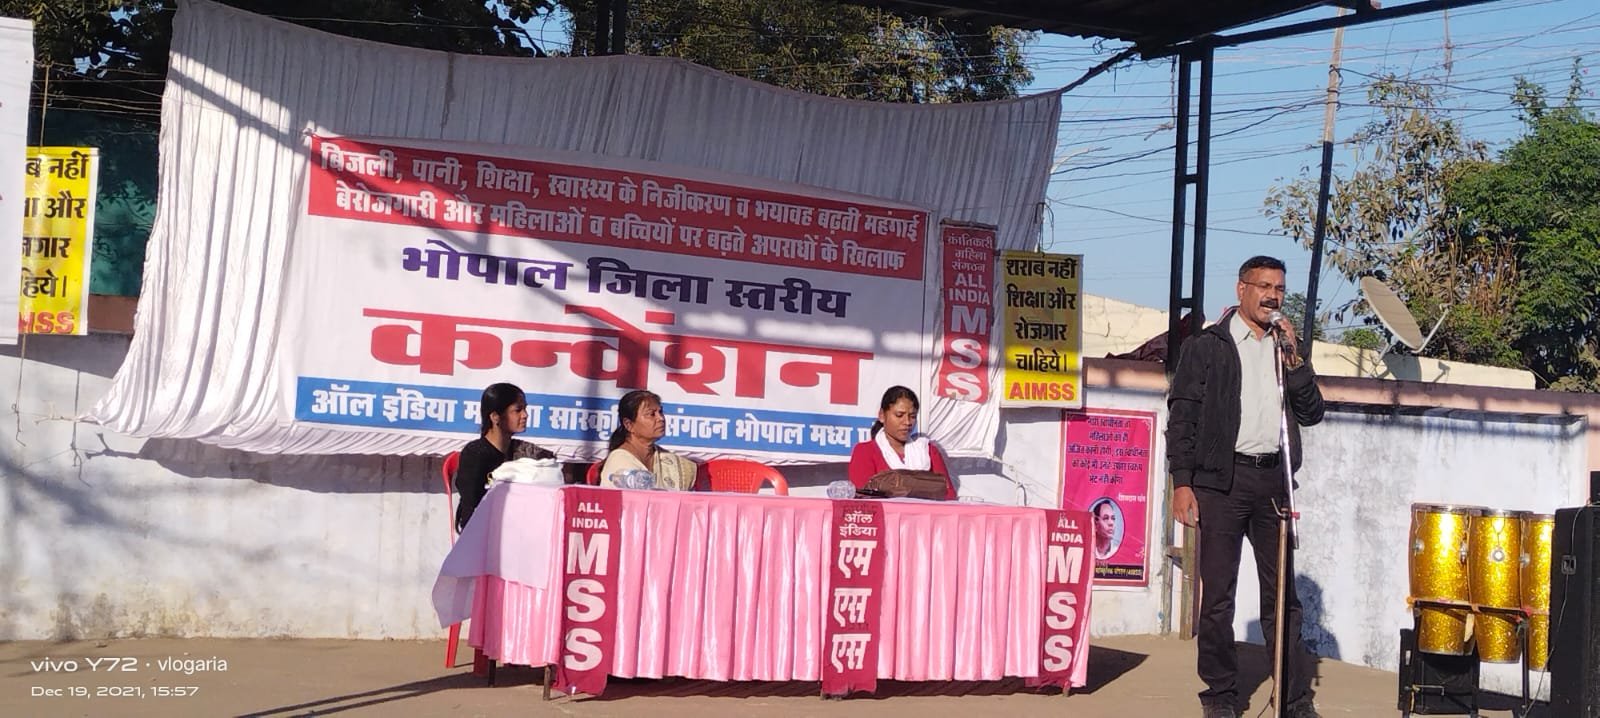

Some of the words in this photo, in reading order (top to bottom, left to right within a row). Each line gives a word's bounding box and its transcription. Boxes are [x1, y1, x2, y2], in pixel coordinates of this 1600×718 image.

[48, 151, 91, 179] नहीं
[320, 142, 403, 183] बिजली,
[413, 157, 468, 191] पानी,
[476, 160, 540, 198] शिक्षा,
[548, 172, 615, 203] स्वास्थ्य
[618, 176, 637, 204] के
[642, 179, 732, 217] निजीकरण
[736, 198, 750, 218] व
[755, 200, 815, 226] भयावह
[818, 206, 862, 235] बढ़ती
[45, 190, 88, 220] और
[336, 180, 438, 220] बेरोजगारी
[443, 193, 486, 225] और
[490, 200, 588, 236] महिलाओं
[589, 215, 605, 238] व
[609, 213, 677, 245] बच्चियों
[679, 226, 704, 248] पर
[707, 225, 747, 256] बढ़ते
[751, 233, 819, 262] अपराधों
[820, 235, 838, 263] के
[842, 240, 906, 270] खिलाफ
[954, 247, 987, 261] महिला
[951, 259, 986, 273] संगठन
[1006, 258, 1045, 278] शराब
[1048, 257, 1078, 279] नहीं
[402, 239, 574, 291] भोपाल
[586, 256, 714, 305] जिला
[725, 277, 852, 318] स्तरीय
[955, 273, 987, 288] ALL
[948, 287, 991, 305] INDIA
[1006, 283, 1045, 309] शिक्षा
[1048, 286, 1077, 310] और
[1014, 316, 1068, 341] रोजगार
[363, 304, 874, 406] कन्वेंशन
[1008, 382, 1075, 401] AIMSS
[311, 383, 377, 418] ऑल
[382, 387, 458, 424] इंडिया
[665, 407, 731, 441] संगठन
[735, 412, 806, 446] भोपाल
[810, 424, 855, 448] मध्य
[577, 501, 604, 513] ALL
[844, 510, 874, 524] ऑल
[571, 517, 609, 530] INDIA
[839, 524, 877, 537] इंडिया
[1057, 519, 1079, 530] ALL
[1050, 532, 1084, 544] INDIA
[838, 540, 877, 579] एम
[833, 587, 873, 627] एस
[830, 633, 872, 674] एस
